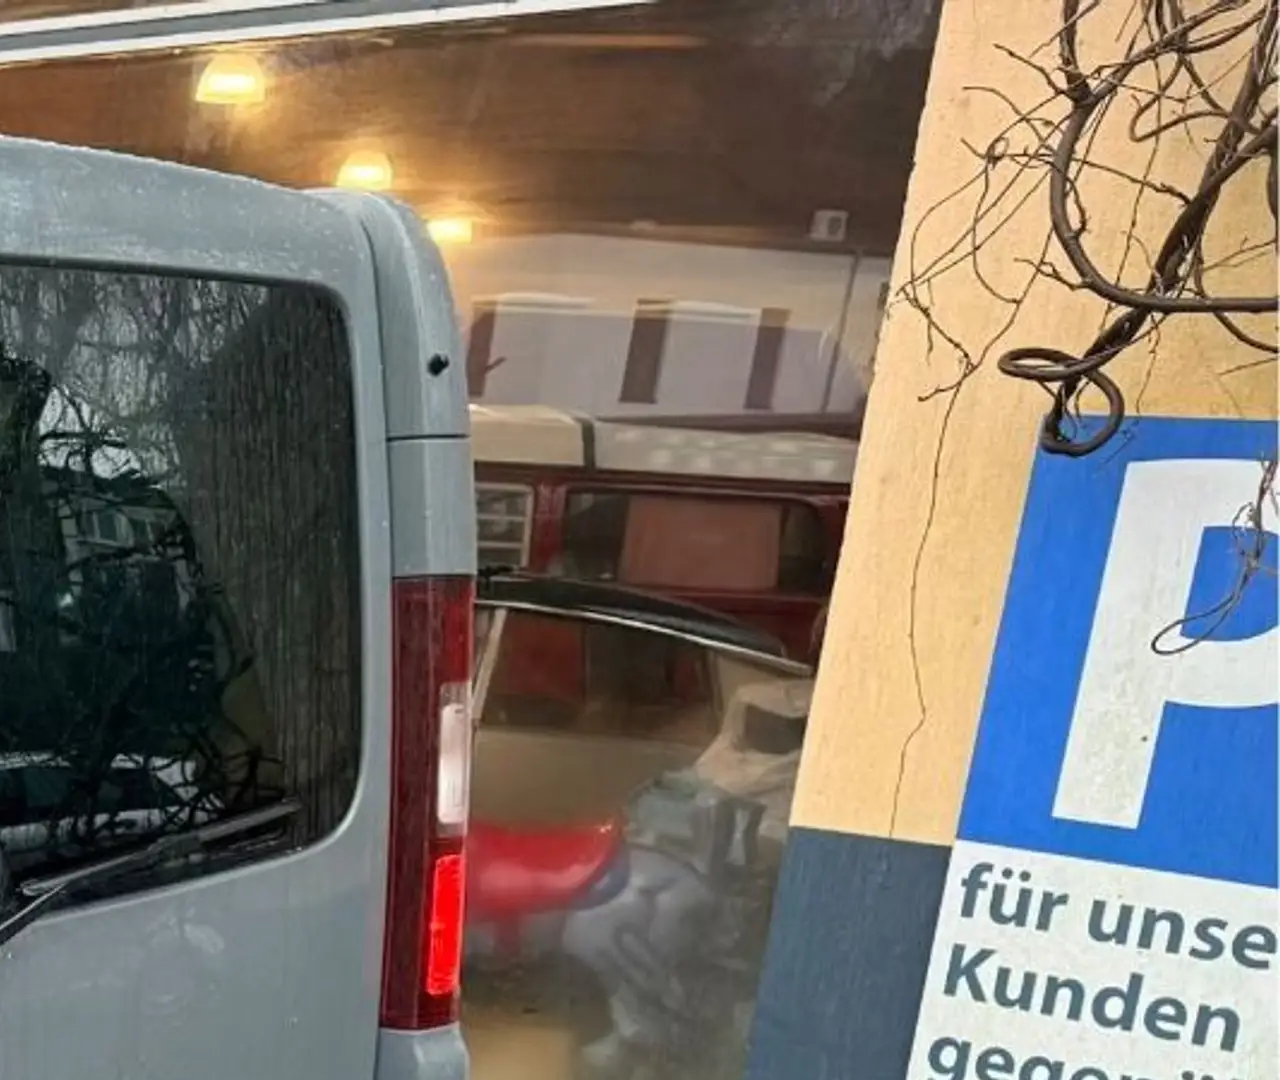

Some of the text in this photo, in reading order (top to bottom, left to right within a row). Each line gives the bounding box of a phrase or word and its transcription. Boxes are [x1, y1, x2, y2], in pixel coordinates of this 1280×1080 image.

[1051, 458, 1279, 830] P
[959, 861, 1070, 932] für
[942, 943, 1241, 1053] Kunden
